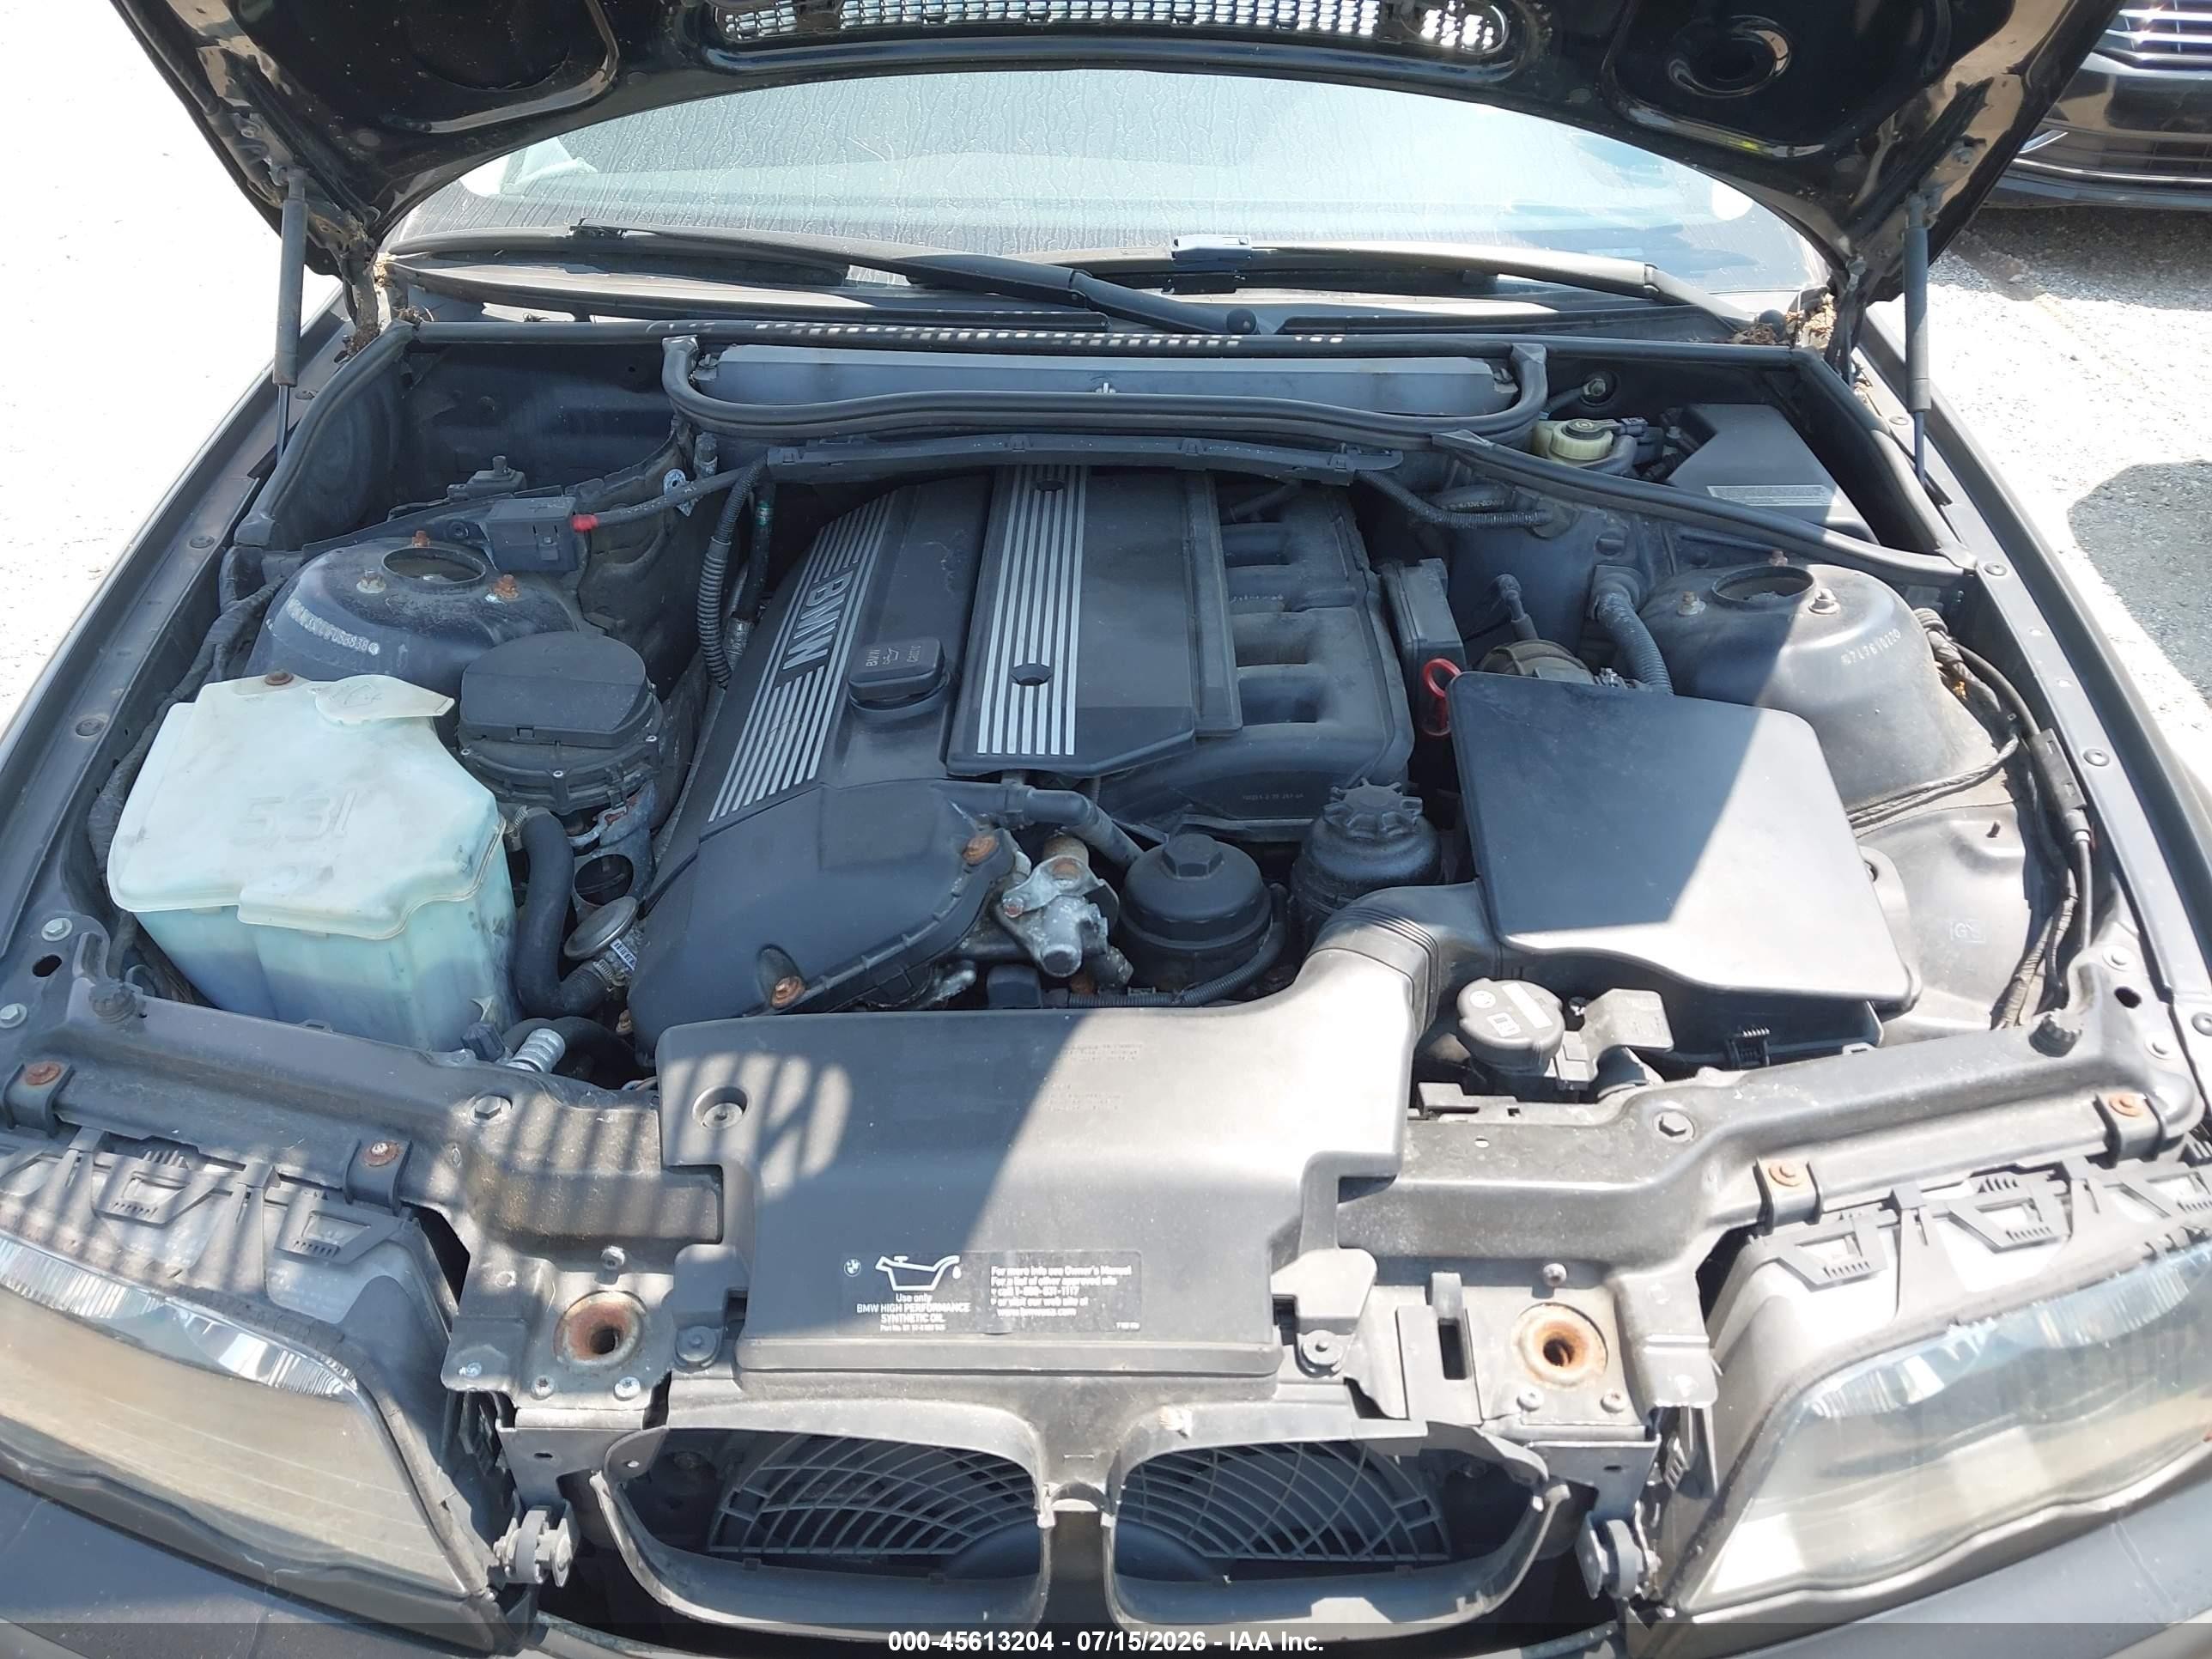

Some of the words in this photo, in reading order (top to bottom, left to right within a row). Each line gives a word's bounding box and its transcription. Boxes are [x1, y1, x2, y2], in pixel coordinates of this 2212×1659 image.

[782, 570, 854, 670] BMW
[896, 1293, 912, 1303] Use
[914, 1293, 933, 1304] only
[856, 1304, 878, 1313] BMW
[880, 1304, 902, 1313] HIGH
[903, 1302, 971, 1312] PERFORMANCE
[880, 1313, 928, 1323] SYNTHETIC
